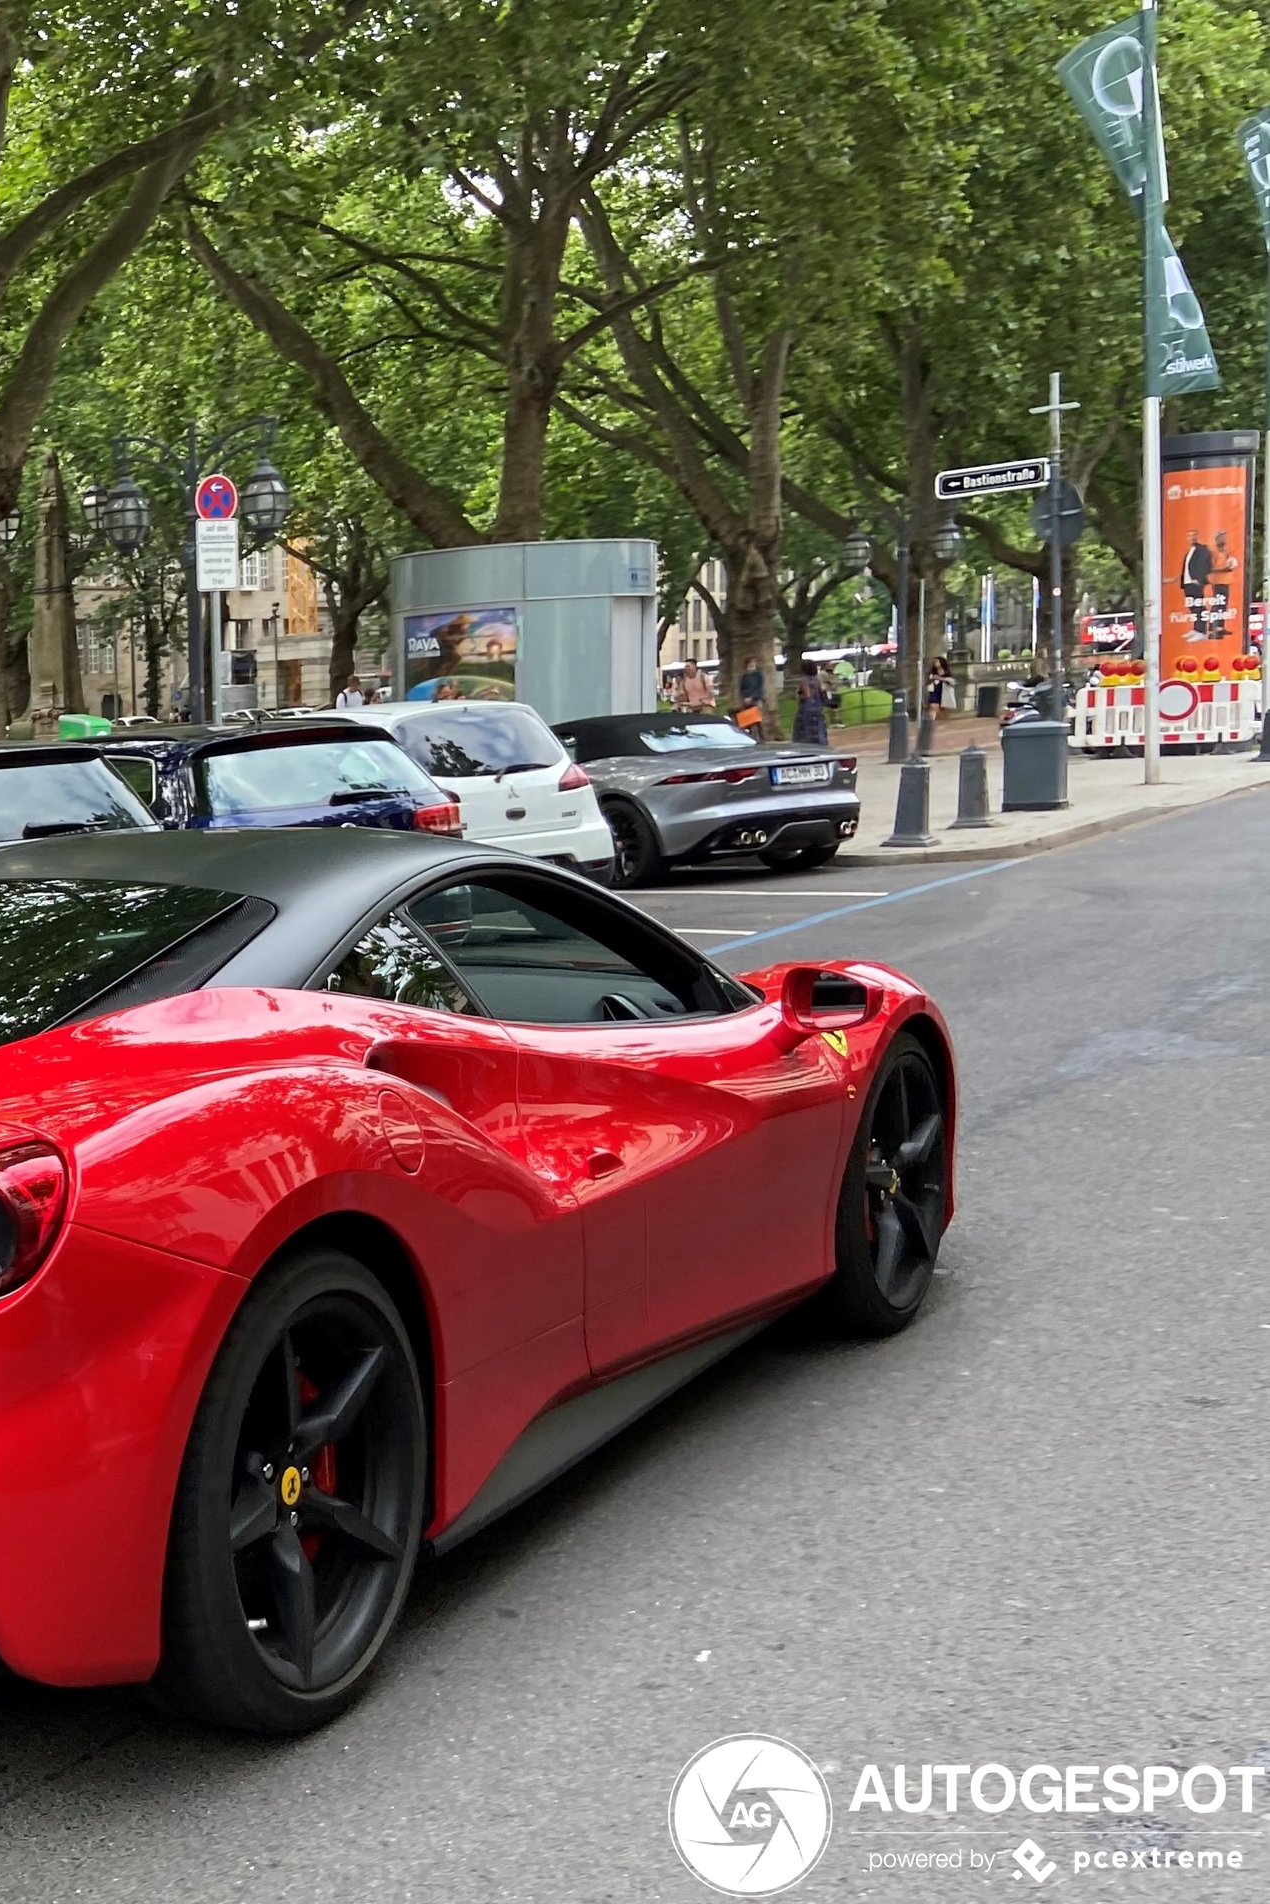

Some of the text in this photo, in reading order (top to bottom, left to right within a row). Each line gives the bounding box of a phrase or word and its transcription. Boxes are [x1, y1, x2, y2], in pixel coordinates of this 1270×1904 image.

[963, 468, 1035, 488] Bastionstraße
[1185, 594, 1226, 607] Bereit
[1170, 611, 1198, 623] fürs
